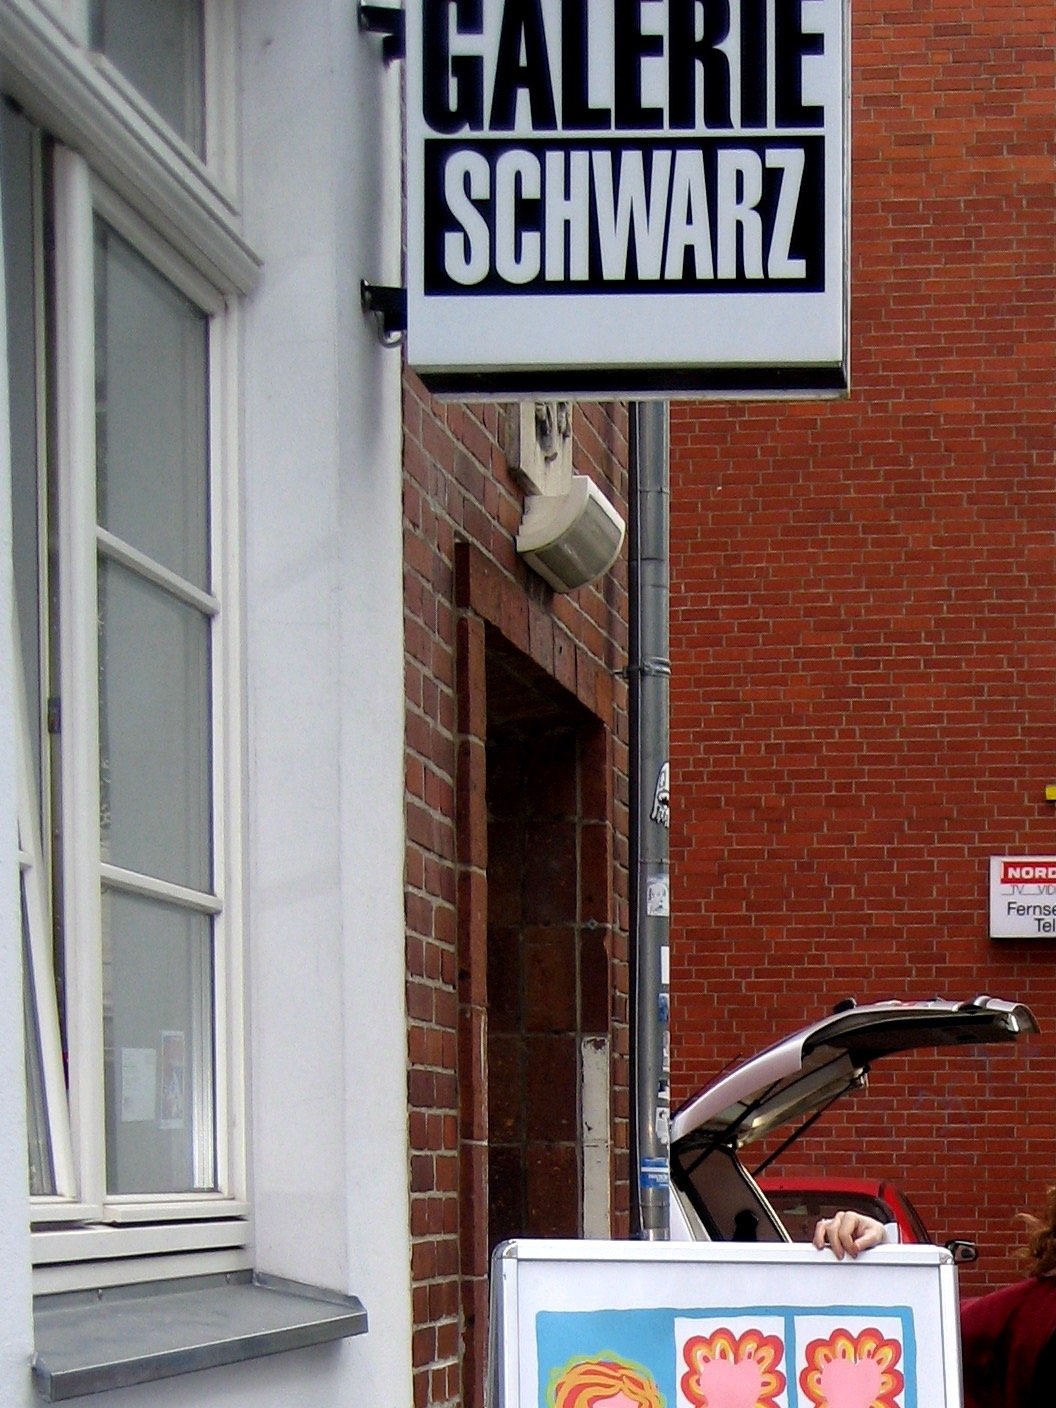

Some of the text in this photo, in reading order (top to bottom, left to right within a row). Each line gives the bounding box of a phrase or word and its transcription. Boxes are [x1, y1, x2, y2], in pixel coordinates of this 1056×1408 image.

[422, 0, 825, 134] GALERIE
[444, 148, 807, 285] SCHWARZ
[1011, 884, 1025, 895] TV
